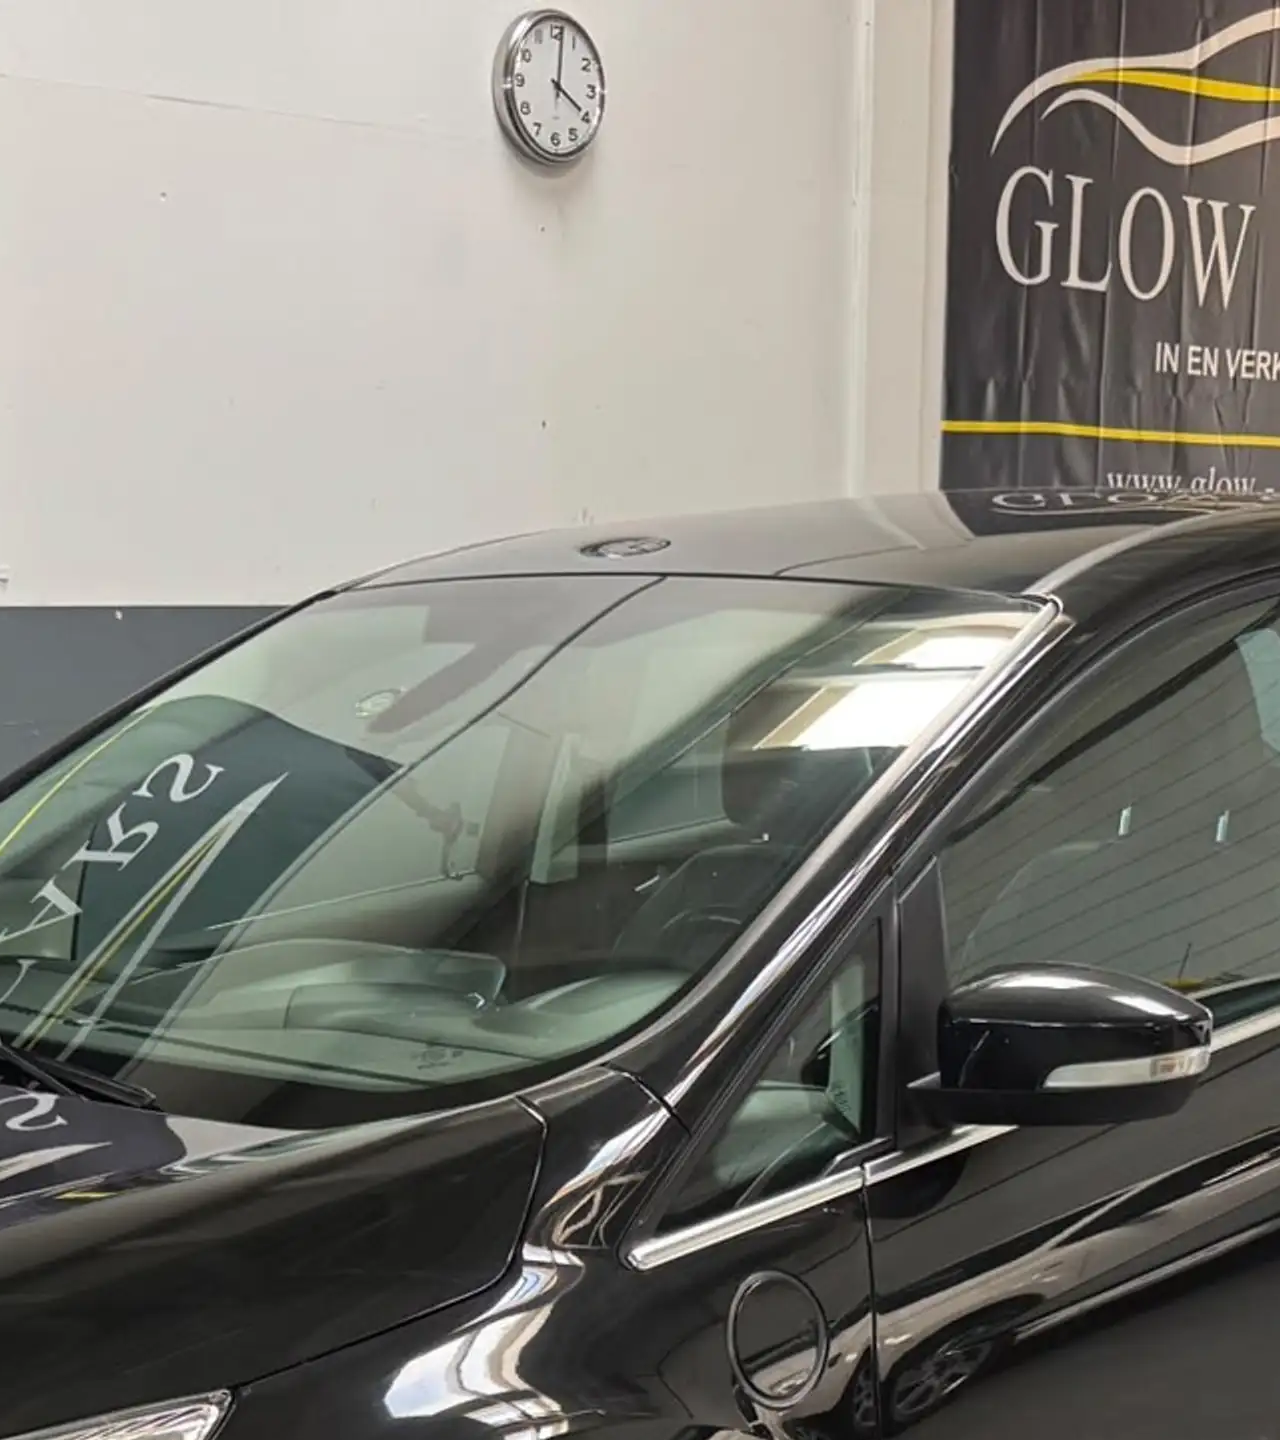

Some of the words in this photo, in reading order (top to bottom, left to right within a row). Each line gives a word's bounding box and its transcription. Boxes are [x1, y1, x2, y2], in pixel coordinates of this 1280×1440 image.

[581, 58, 591, 72] 2
[515, 73, 525, 87] 9
[586, 85, 596, 99] 3
[520, 102, 531, 115] 8
[550, 132, 561, 146] 6
[568, 128, 578, 141] 5
[995, 166, 1256, 310] GLOW
[1155, 342, 1180, 375] IN
[1187, 346, 1219, 378] EN
